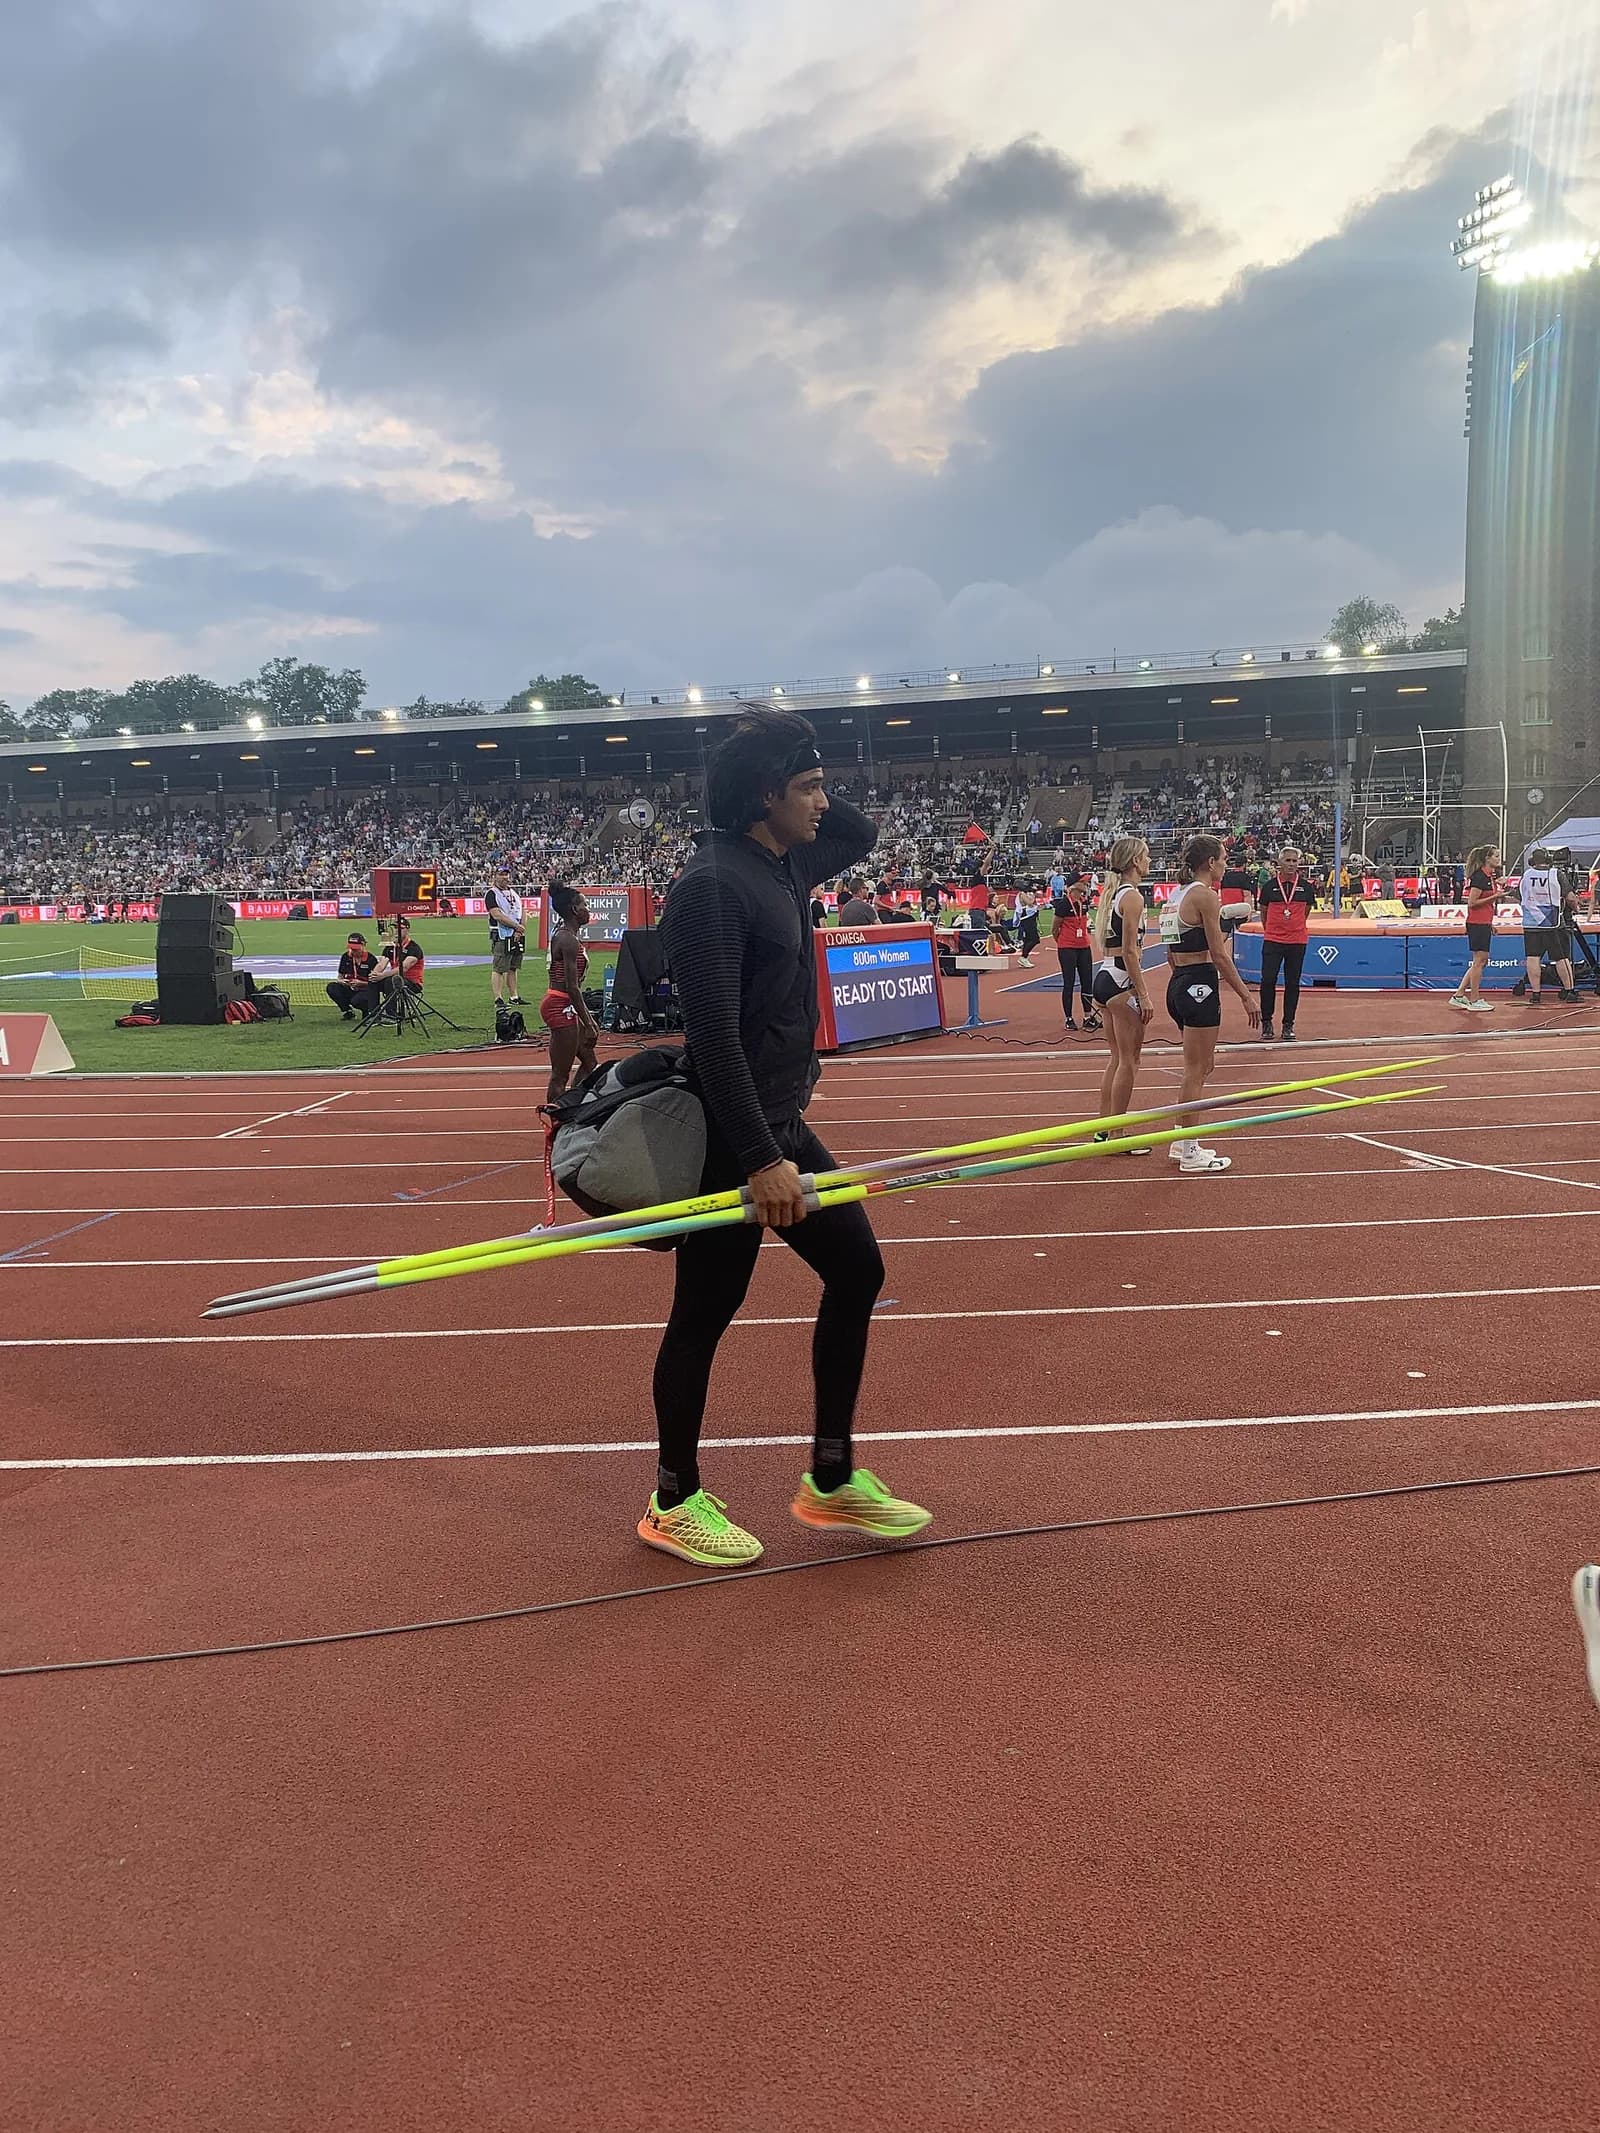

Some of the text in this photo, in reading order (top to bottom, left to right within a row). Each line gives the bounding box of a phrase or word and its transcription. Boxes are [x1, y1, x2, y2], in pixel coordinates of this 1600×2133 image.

[418, 873, 434, 900] 2
[1530, 877, 1549, 887] TV
[247, 903, 293, 916] BAUHA
[616, 898, 622, 909] Y
[589, 912, 610, 921] RANK
[619, 913, 627, 925] 5
[835, 932, 866, 945] OMEGA
[853, 949, 910, 966] 800m Women
[833, 974, 934, 1007] READY TO START
[1196, 987, 1204, 997] 6
